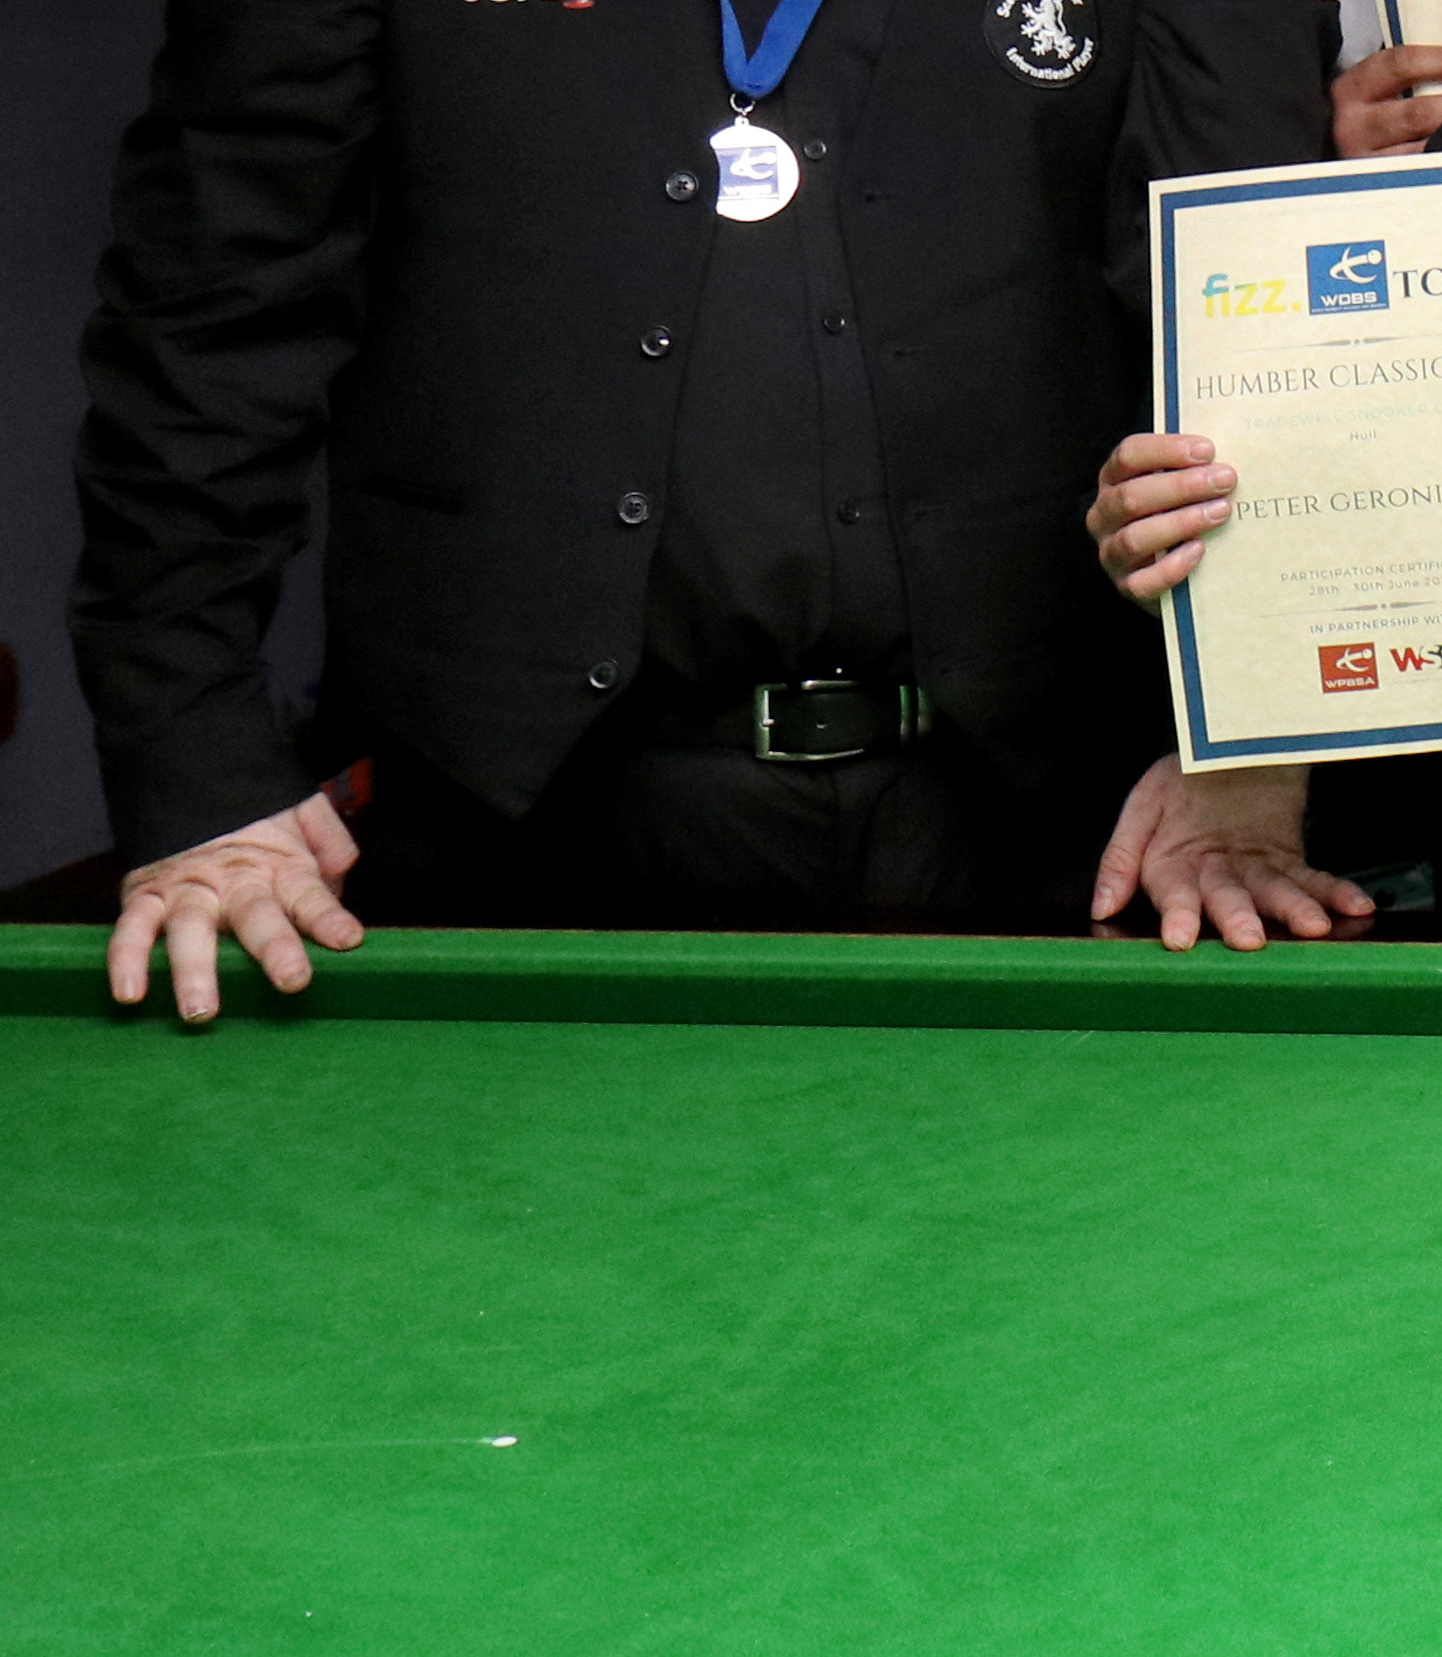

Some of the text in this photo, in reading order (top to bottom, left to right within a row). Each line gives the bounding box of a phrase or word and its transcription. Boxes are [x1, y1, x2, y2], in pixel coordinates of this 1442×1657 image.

[1202, 273, 1300, 319] fizz.
[1320, 291, 1377, 306] WDBS
[1196, 367, 1320, 399] HUMBER
[1350, 429, 1378, 441] Hull
[1235, 495, 1321, 521] PETER
[1281, 565, 1384, 582] PARTICIPATION
[1389, 579, 1420, 591] June
[1310, 624, 1323, 634] IN
[1329, 616, 1419, 632] PARTNERSHIP
[1325, 676, 1376, 689] WPBSA
